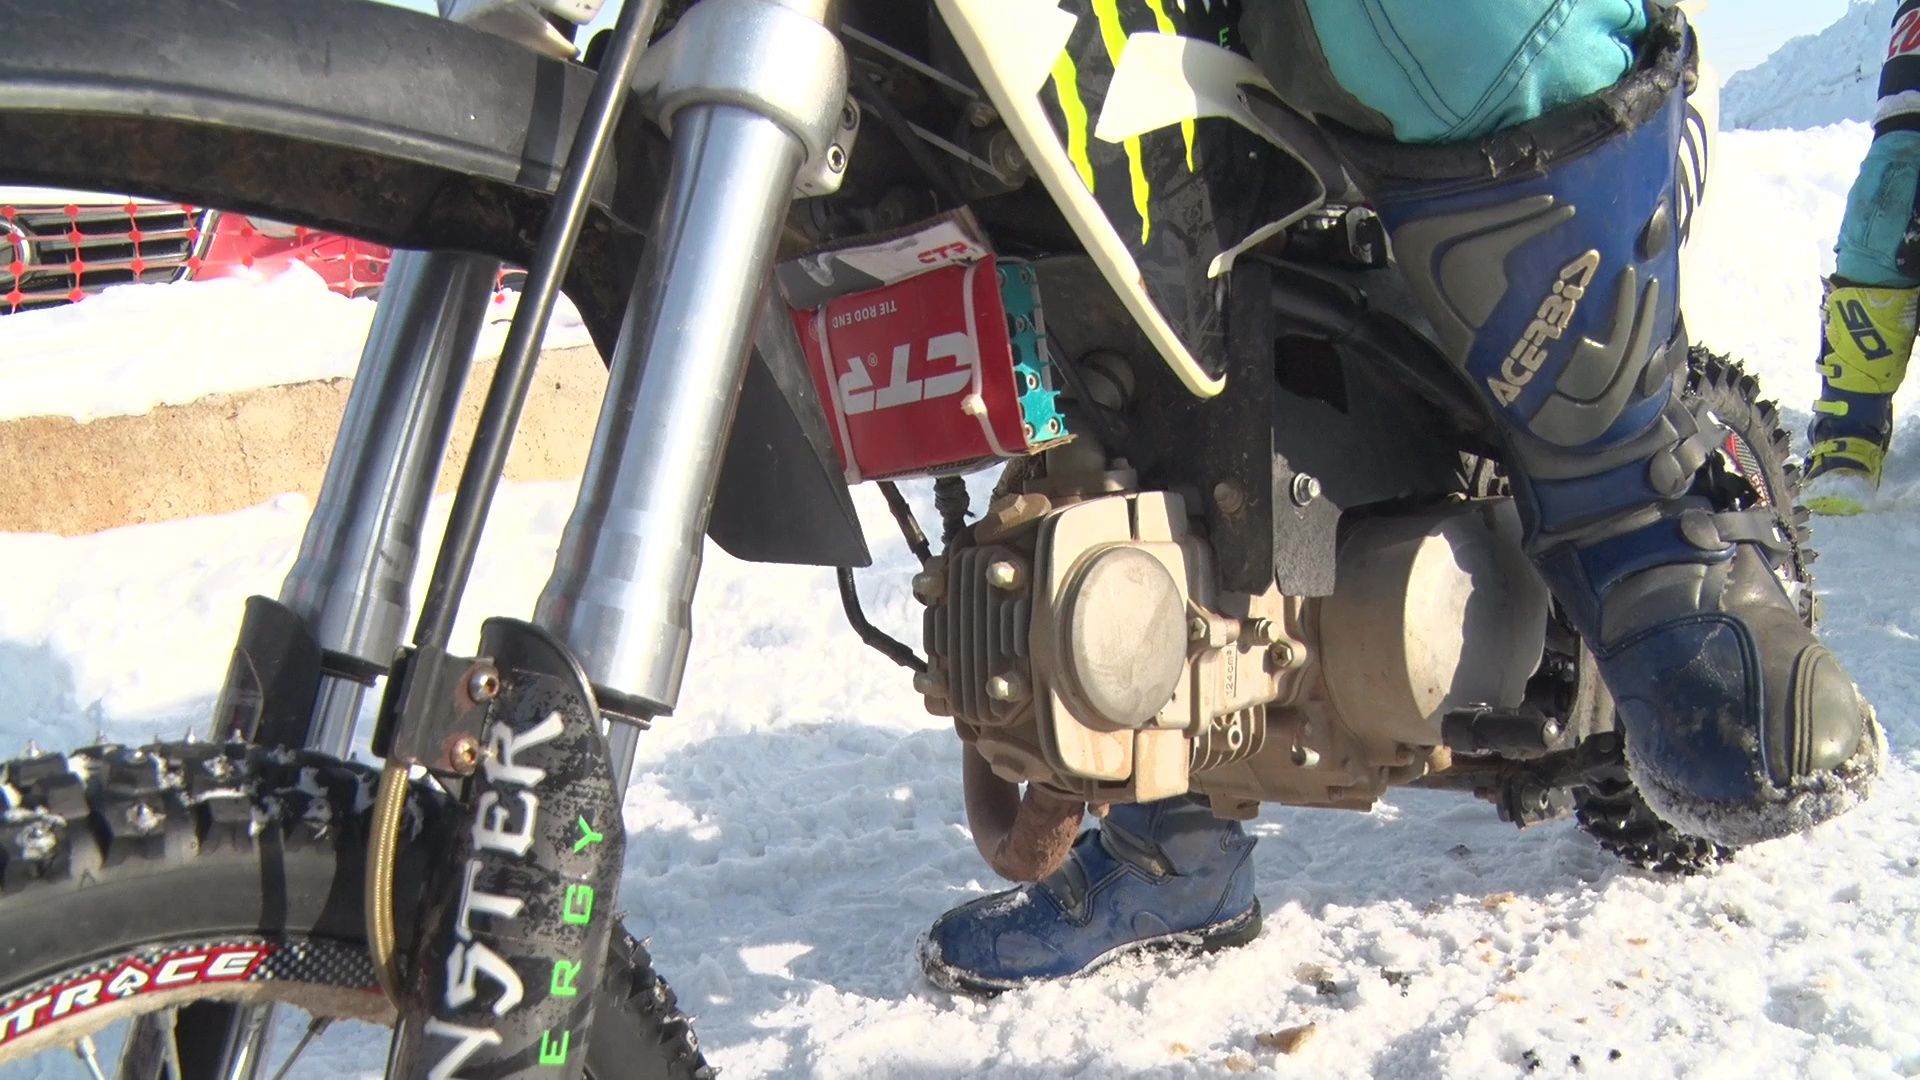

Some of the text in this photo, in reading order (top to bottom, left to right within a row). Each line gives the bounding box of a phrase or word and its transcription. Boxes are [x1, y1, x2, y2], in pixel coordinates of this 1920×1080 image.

[832, 300, 897, 329] TIE ROD END
